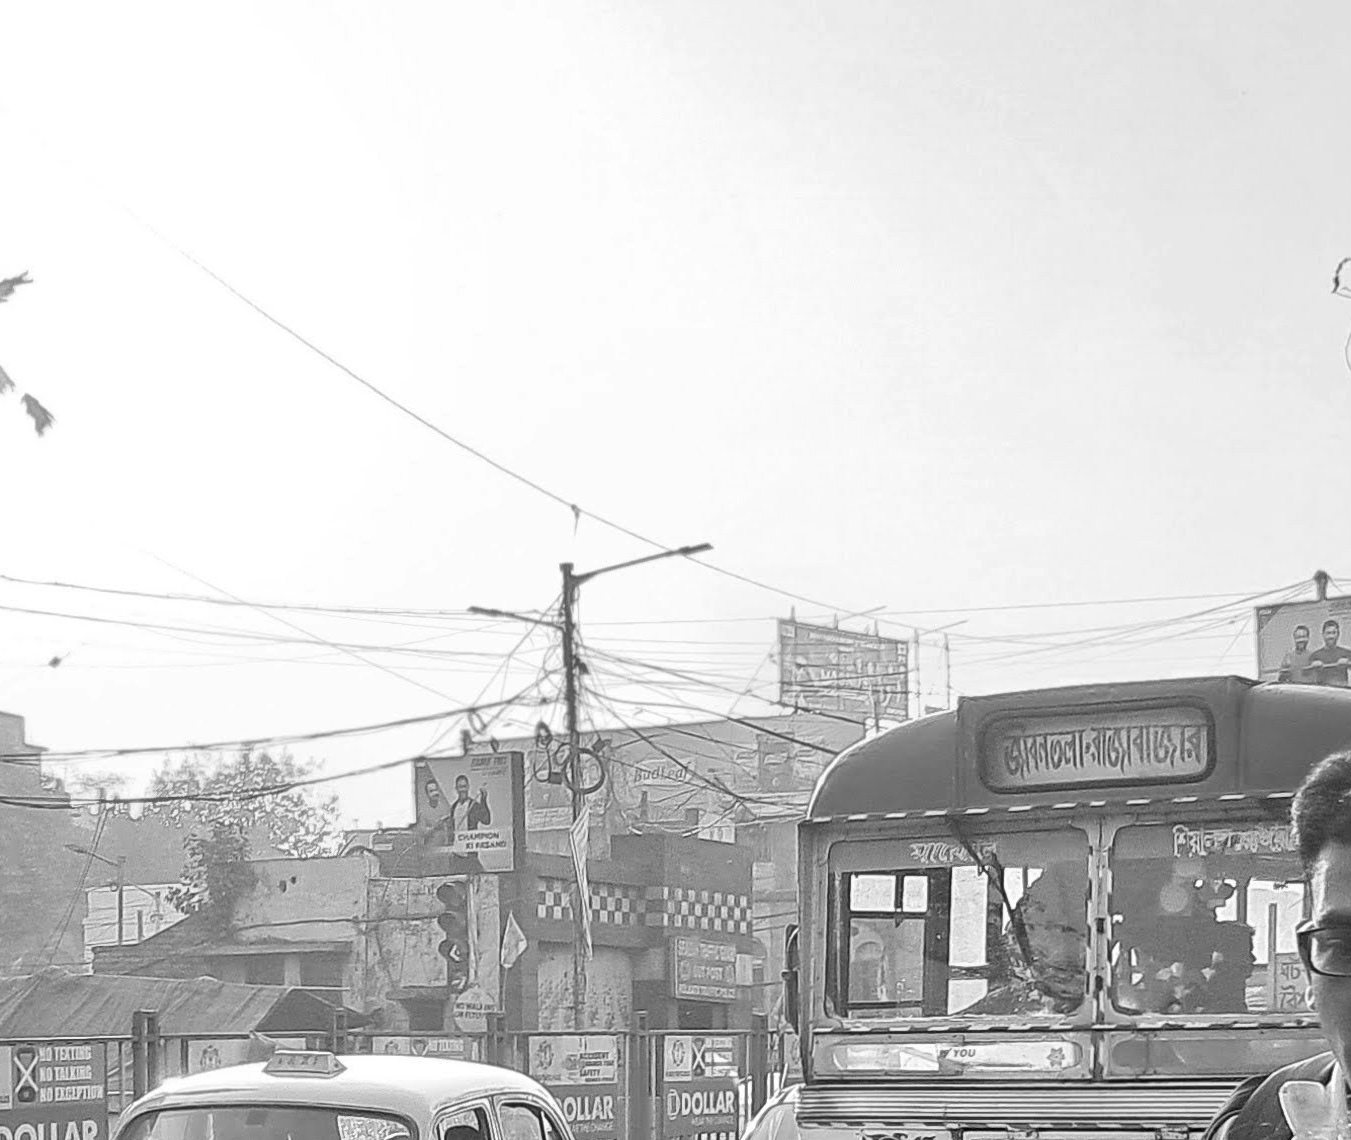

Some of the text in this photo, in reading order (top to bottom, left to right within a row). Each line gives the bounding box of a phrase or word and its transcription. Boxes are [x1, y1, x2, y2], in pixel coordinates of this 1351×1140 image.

[39, 1046, 92, 1062] NO TEXTING
[954, 1049, 976, 1058] YOU
[39, 1065, 92, 1082] NO TALKING
[39, 1085, 104, 1102] NO EXCEPTION
[681, 1091, 735, 1116] DOLLAR
